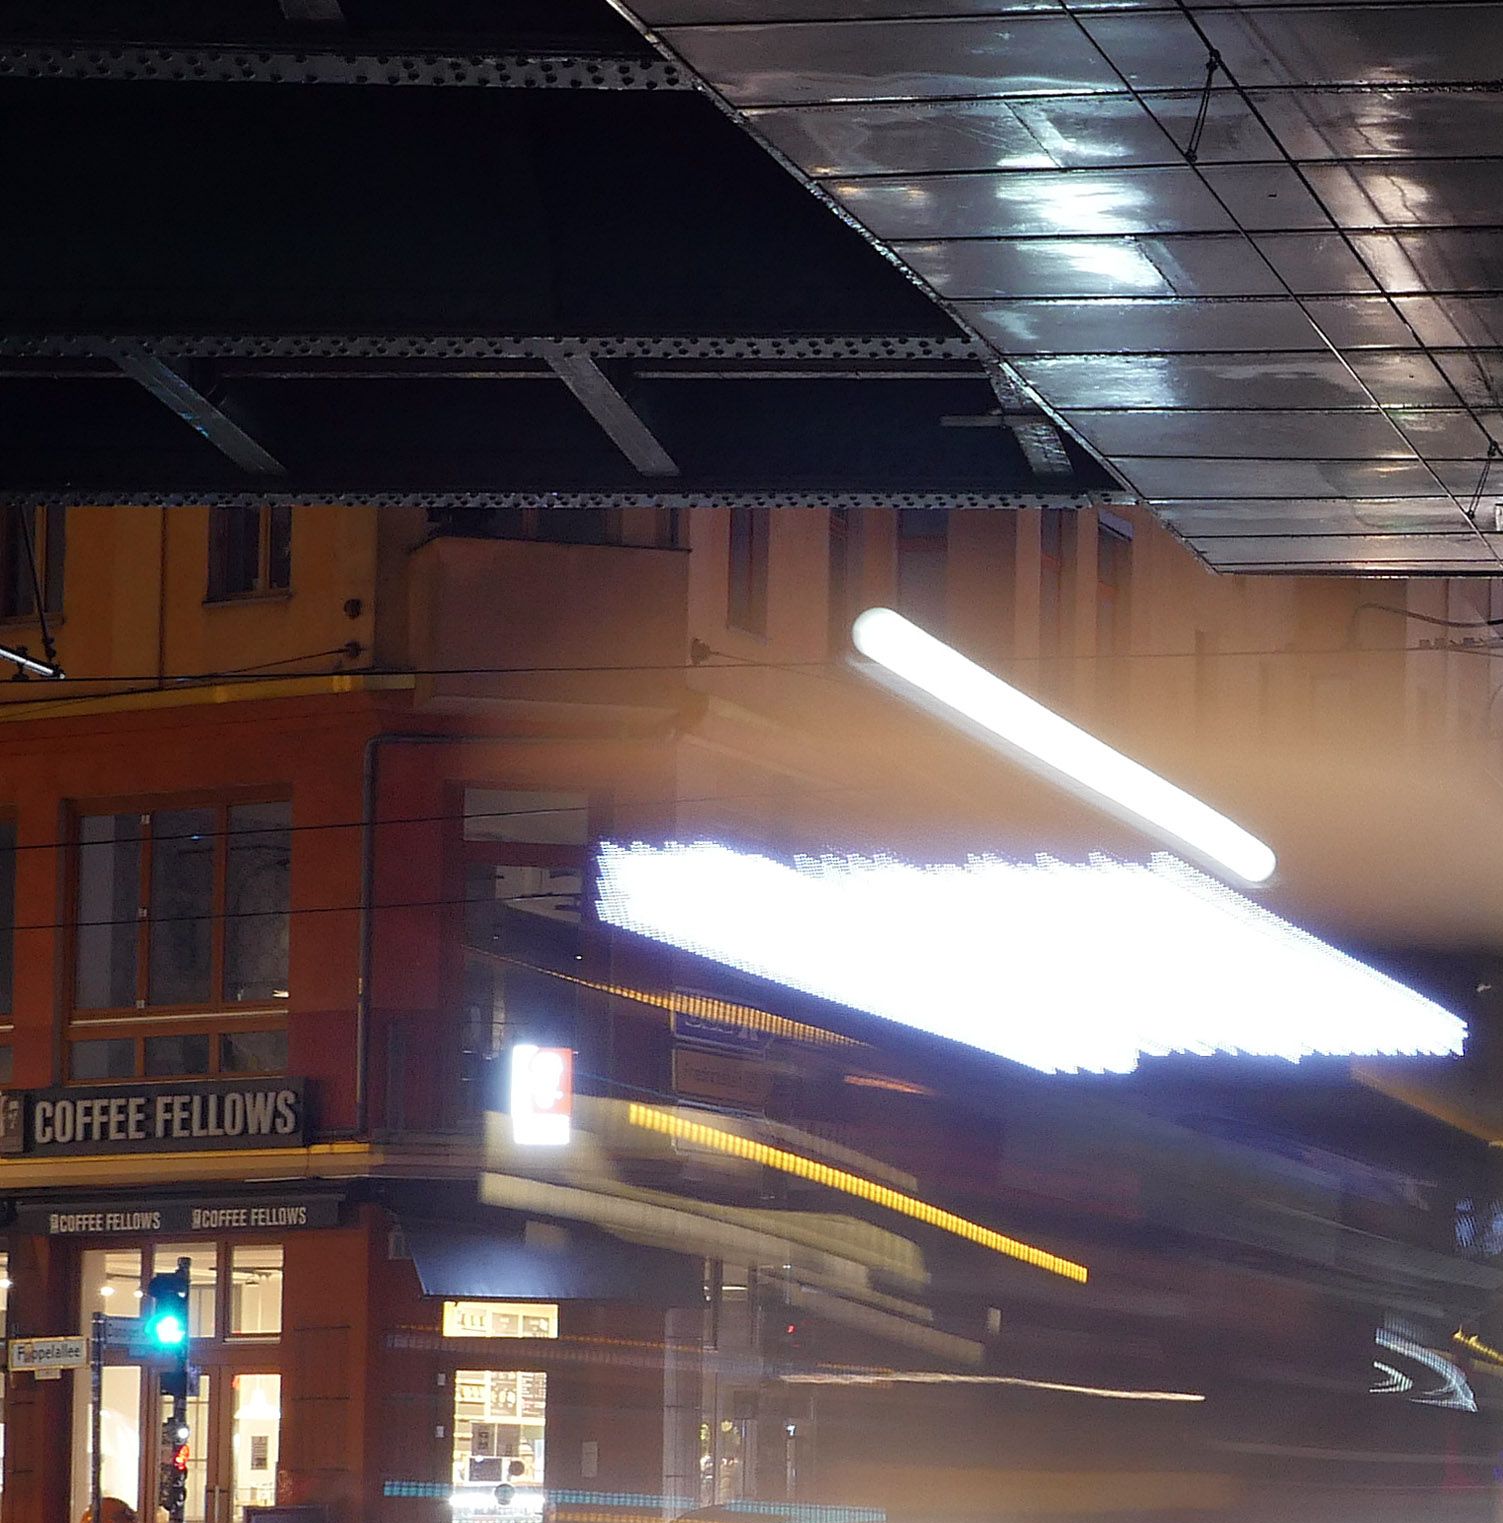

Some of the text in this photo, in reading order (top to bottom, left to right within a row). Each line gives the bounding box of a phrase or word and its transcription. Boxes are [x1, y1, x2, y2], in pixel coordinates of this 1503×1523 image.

[35, 1097, 146, 1144] COFFEE
[155, 1089, 297, 1139] FELLOWS
[60, 1212, 161, 1232] COFFEE FELLOWS
[201, 1207, 307, 1228] COFFEE FELLOWS
